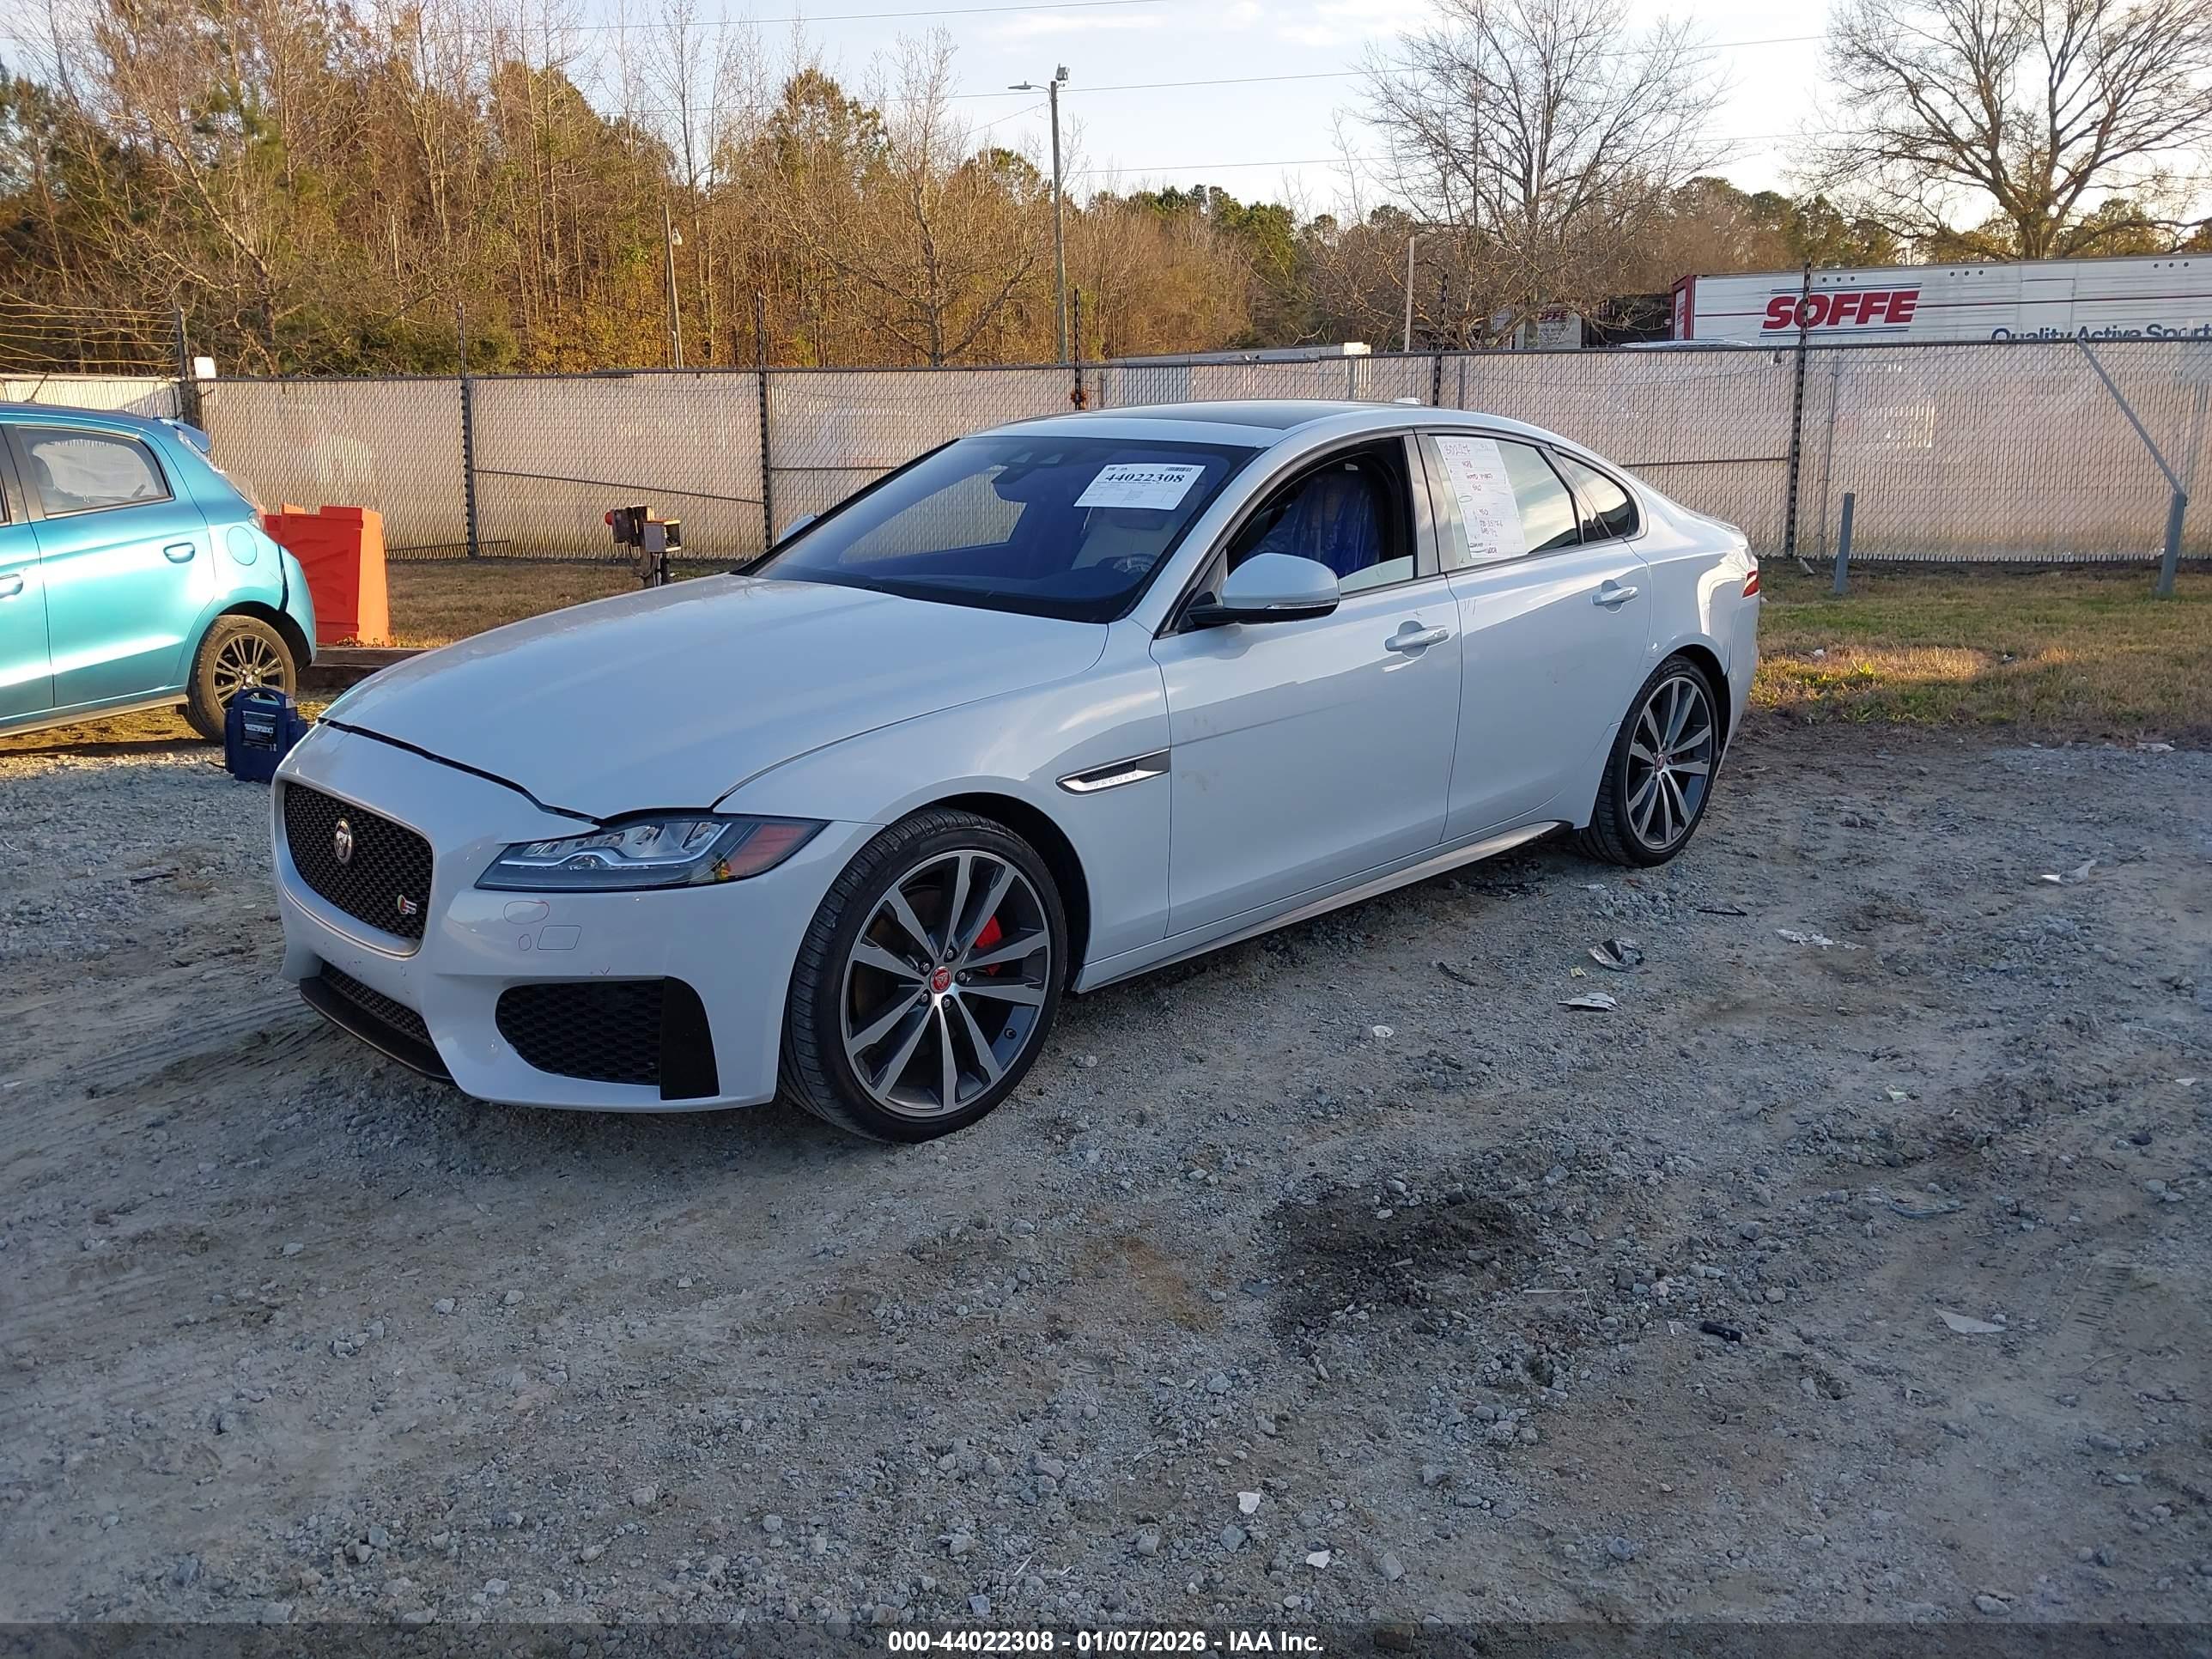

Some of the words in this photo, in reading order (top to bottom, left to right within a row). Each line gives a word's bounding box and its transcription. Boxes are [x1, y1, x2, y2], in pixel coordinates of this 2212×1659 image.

[1762, 290, 1920, 330] SOFFE
[1105, 473, 1185, 483] 44022308
[1093, 773, 1138, 787] JAGUAR
